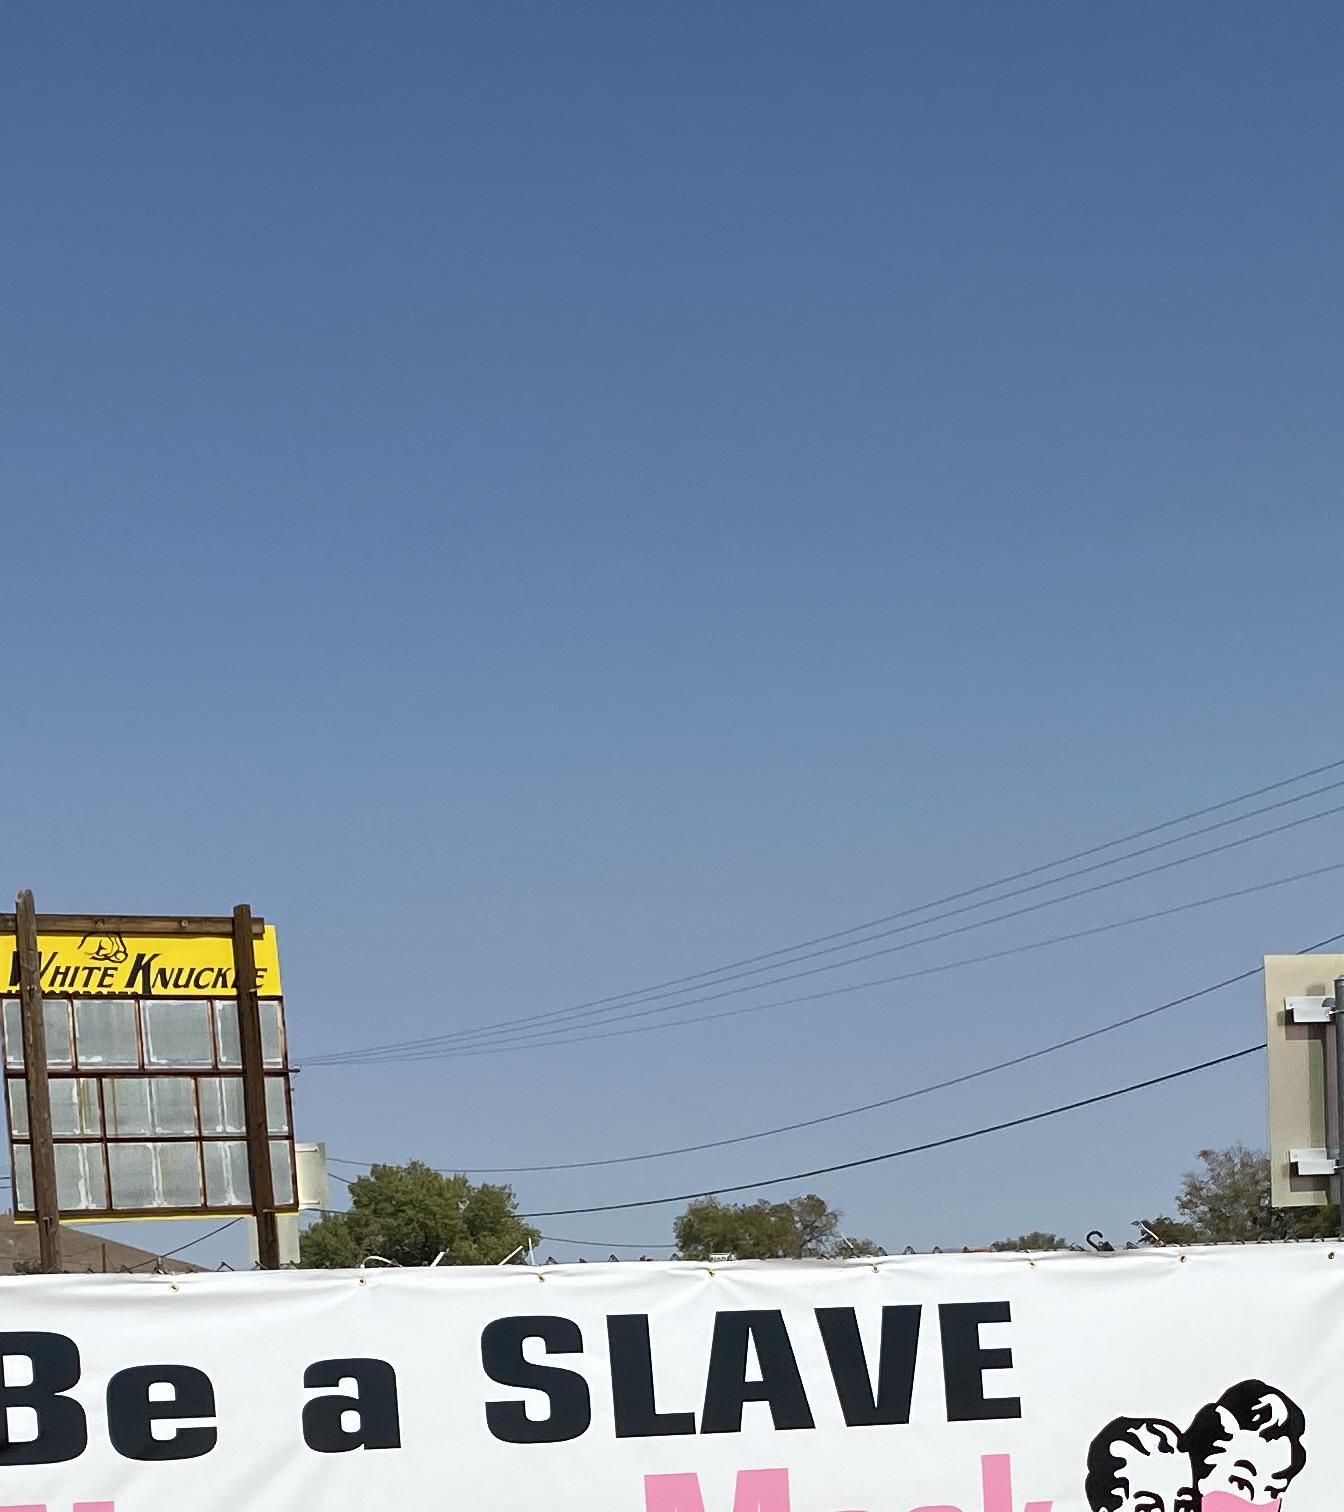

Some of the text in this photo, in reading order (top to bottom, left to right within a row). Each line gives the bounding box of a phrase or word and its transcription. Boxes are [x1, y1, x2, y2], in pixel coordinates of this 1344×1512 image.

[124, 953, 267, 995] KNUCKE
[301, 1357, 402, 1454] a
[480, 1300, 1023, 1444] SLAVE
